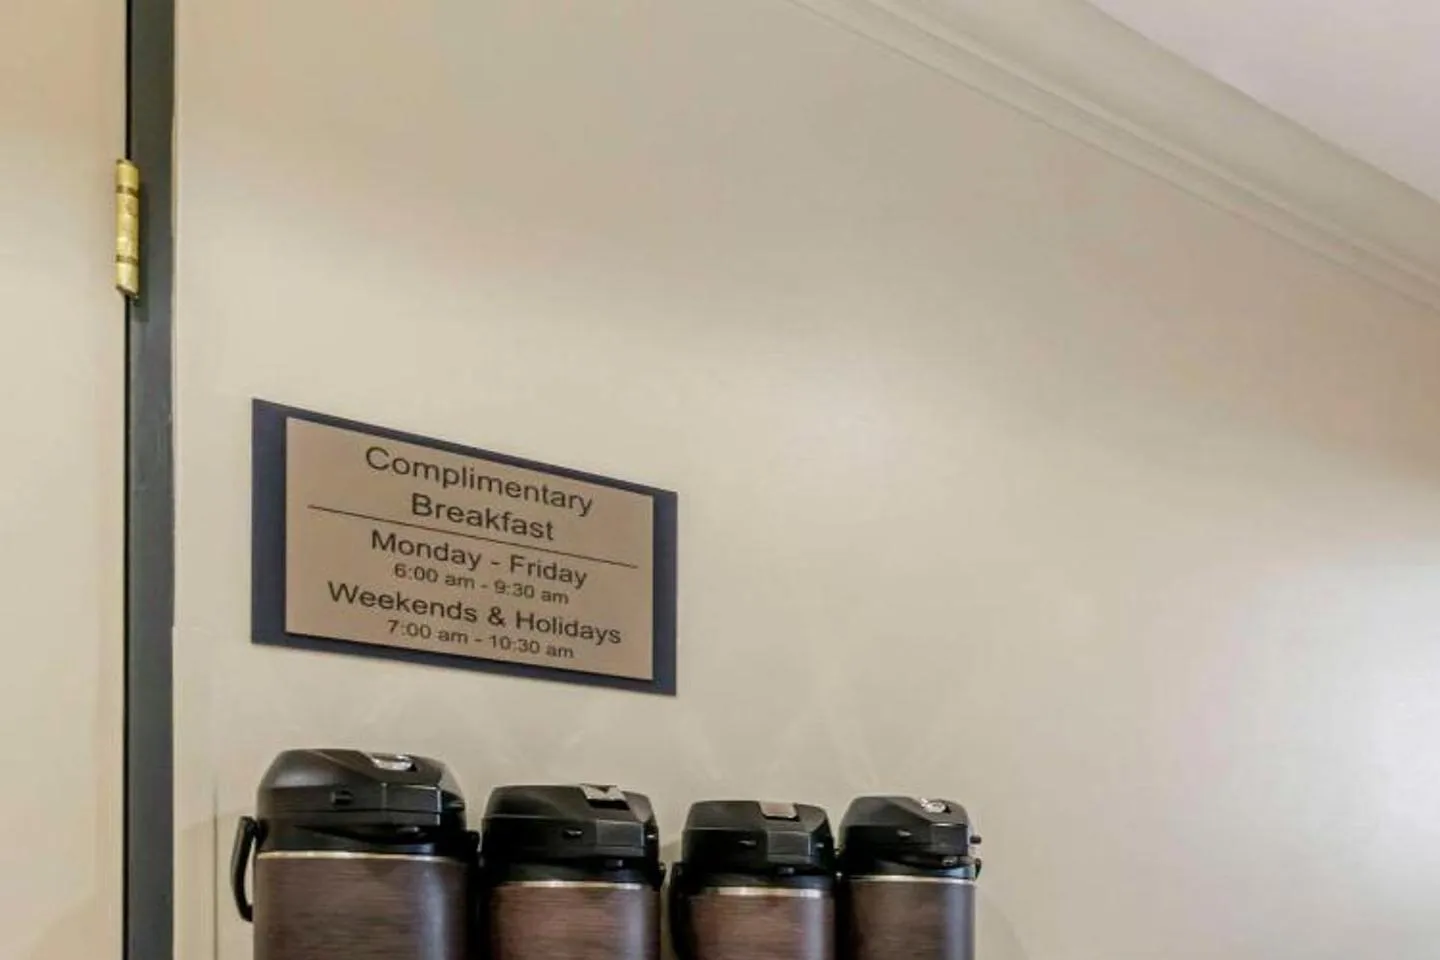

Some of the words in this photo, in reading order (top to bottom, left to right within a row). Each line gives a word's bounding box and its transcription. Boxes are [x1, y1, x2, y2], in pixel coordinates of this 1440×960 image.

[365, 446, 593, 518] Complimentary
[412, 492, 554, 541] Breakfast
[371, 529, 482, 572] Monday
[510, 554, 588, 590] Friday
[394, 562, 439, 584] 6:00
[444, 574, 475, 590] am
[494, 579, 535, 600] 9:30
[541, 589, 569, 605] am
[328, 580, 478, 623] Weekends
[488, 605, 506, 628] &
[515, 610, 622, 647] Holidays
[388, 619, 432, 640] 7:00
[438, 629, 468, 645] am
[489, 635, 541, 655] 10:30
[546, 644, 574, 660] am
